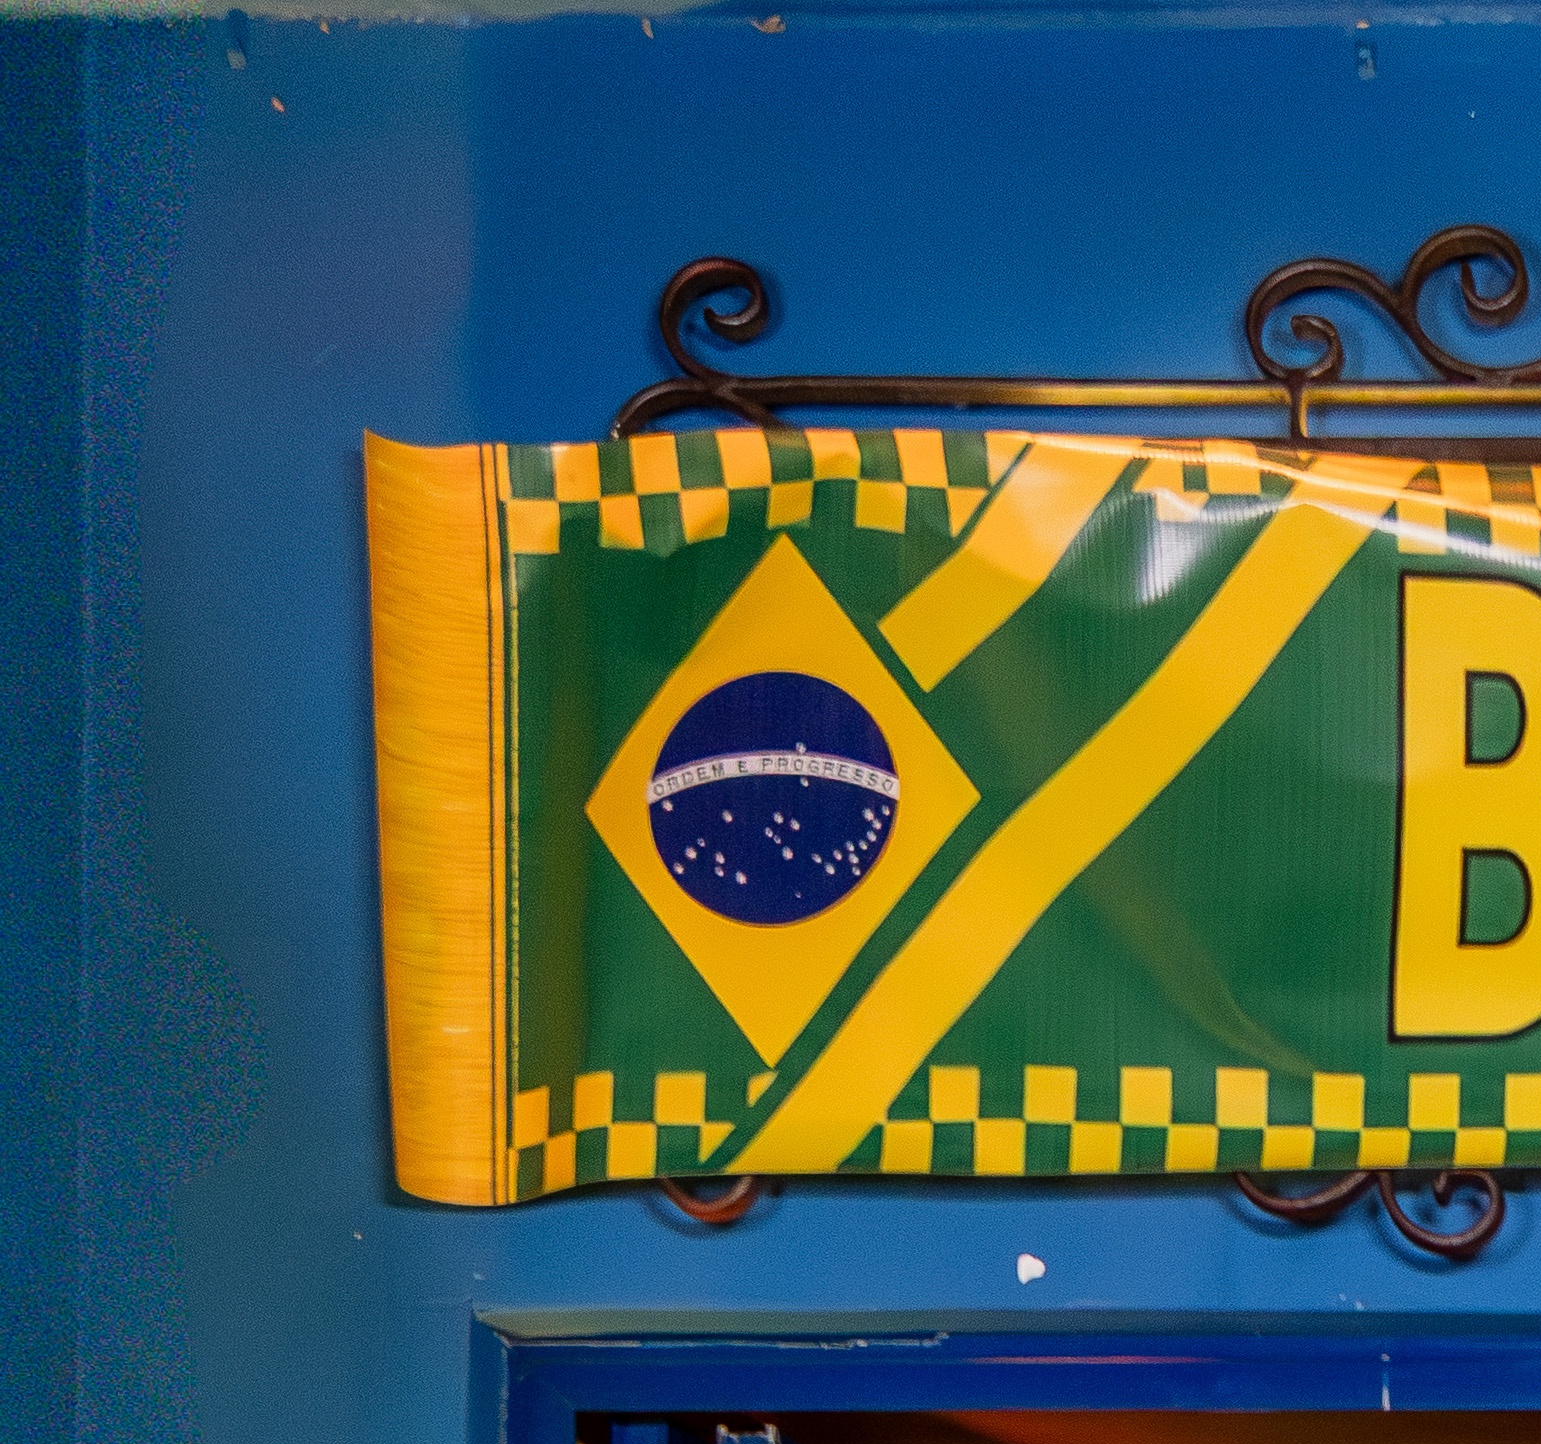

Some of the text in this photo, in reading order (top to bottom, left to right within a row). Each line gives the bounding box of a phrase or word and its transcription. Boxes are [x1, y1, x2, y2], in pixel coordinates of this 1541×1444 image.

[652, 756, 894, 797] ORDEM E PROGRESSO
